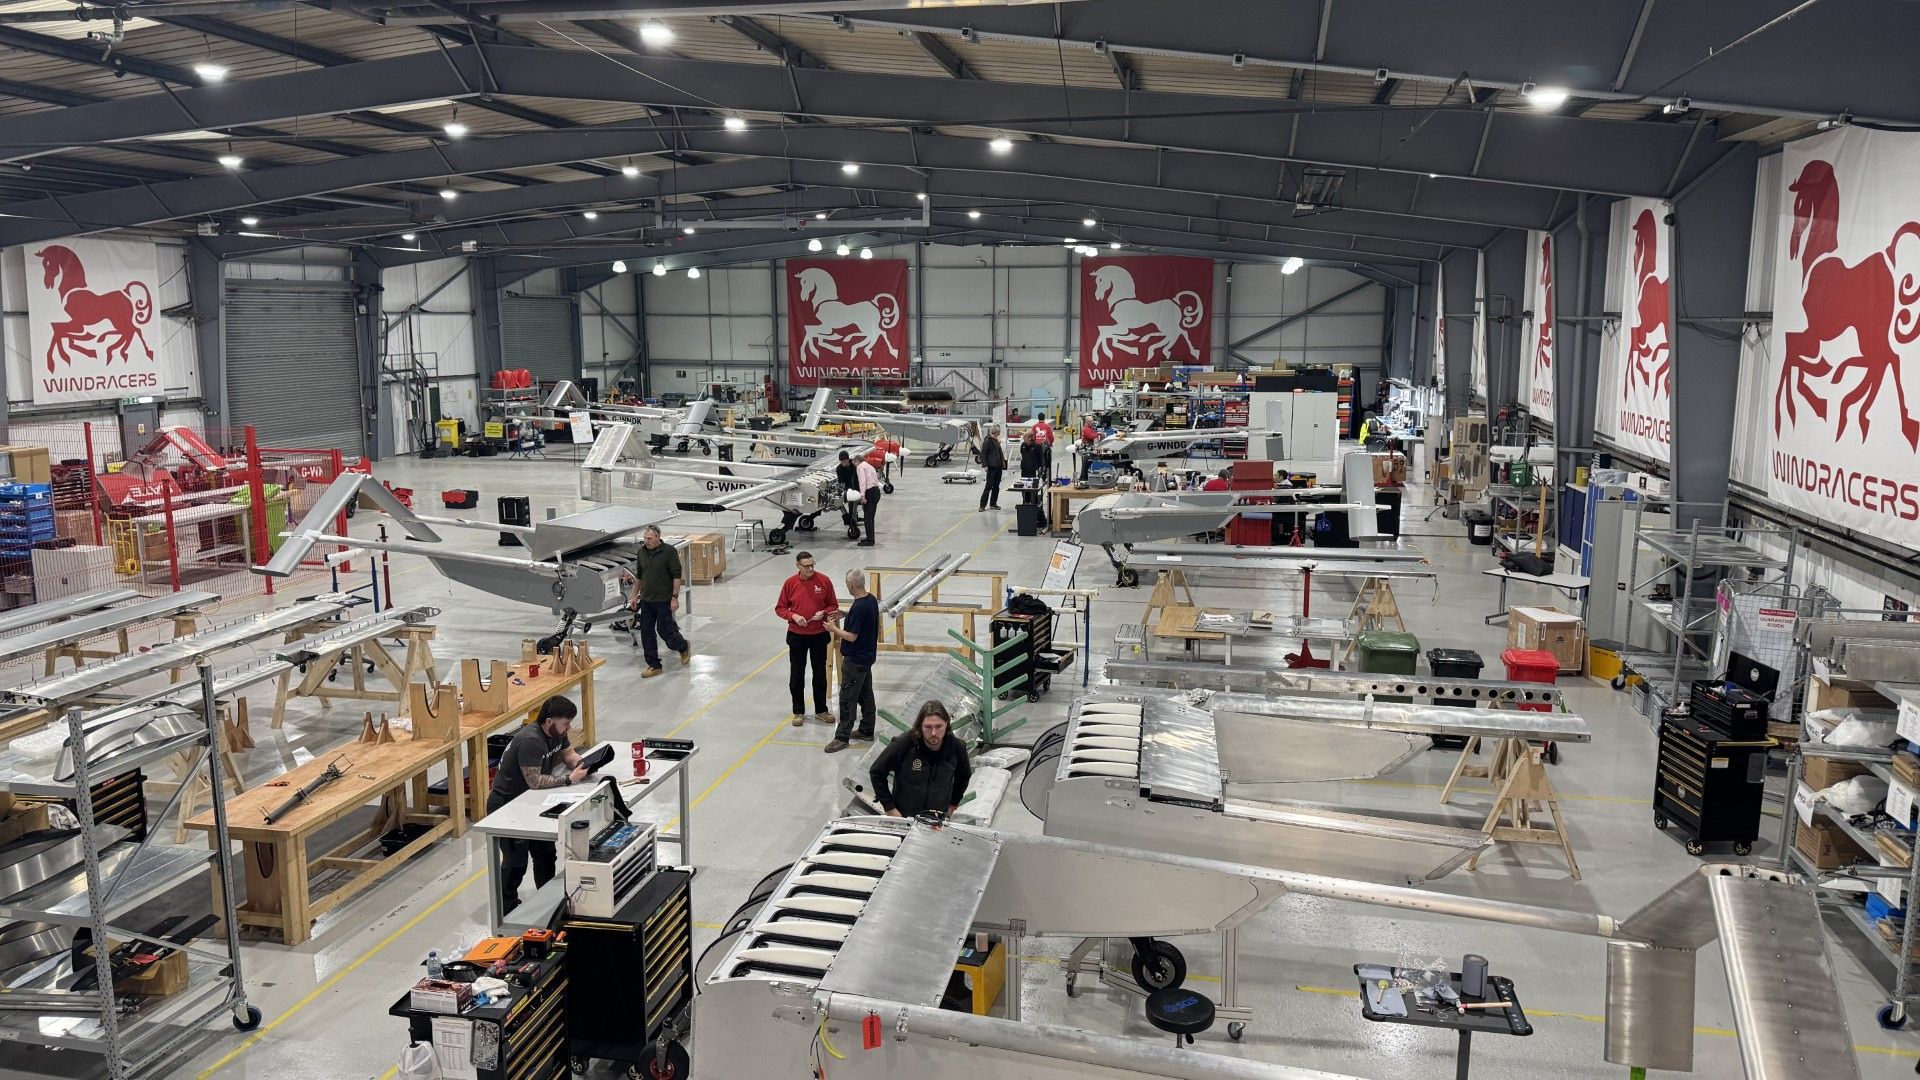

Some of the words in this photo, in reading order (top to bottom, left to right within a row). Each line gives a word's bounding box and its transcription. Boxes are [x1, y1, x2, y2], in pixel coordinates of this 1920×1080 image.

[42, 373, 158, 393] WINDRACERS
[1147, 440, 1187, 451] G-WNDG
[774, 446, 817, 458] G-WNDB
[706, 480, 754, 493] G-WND
[1772, 448, 1920, 522] WINDRACERS
[1759, 616, 1794, 625] QUARANTINE
